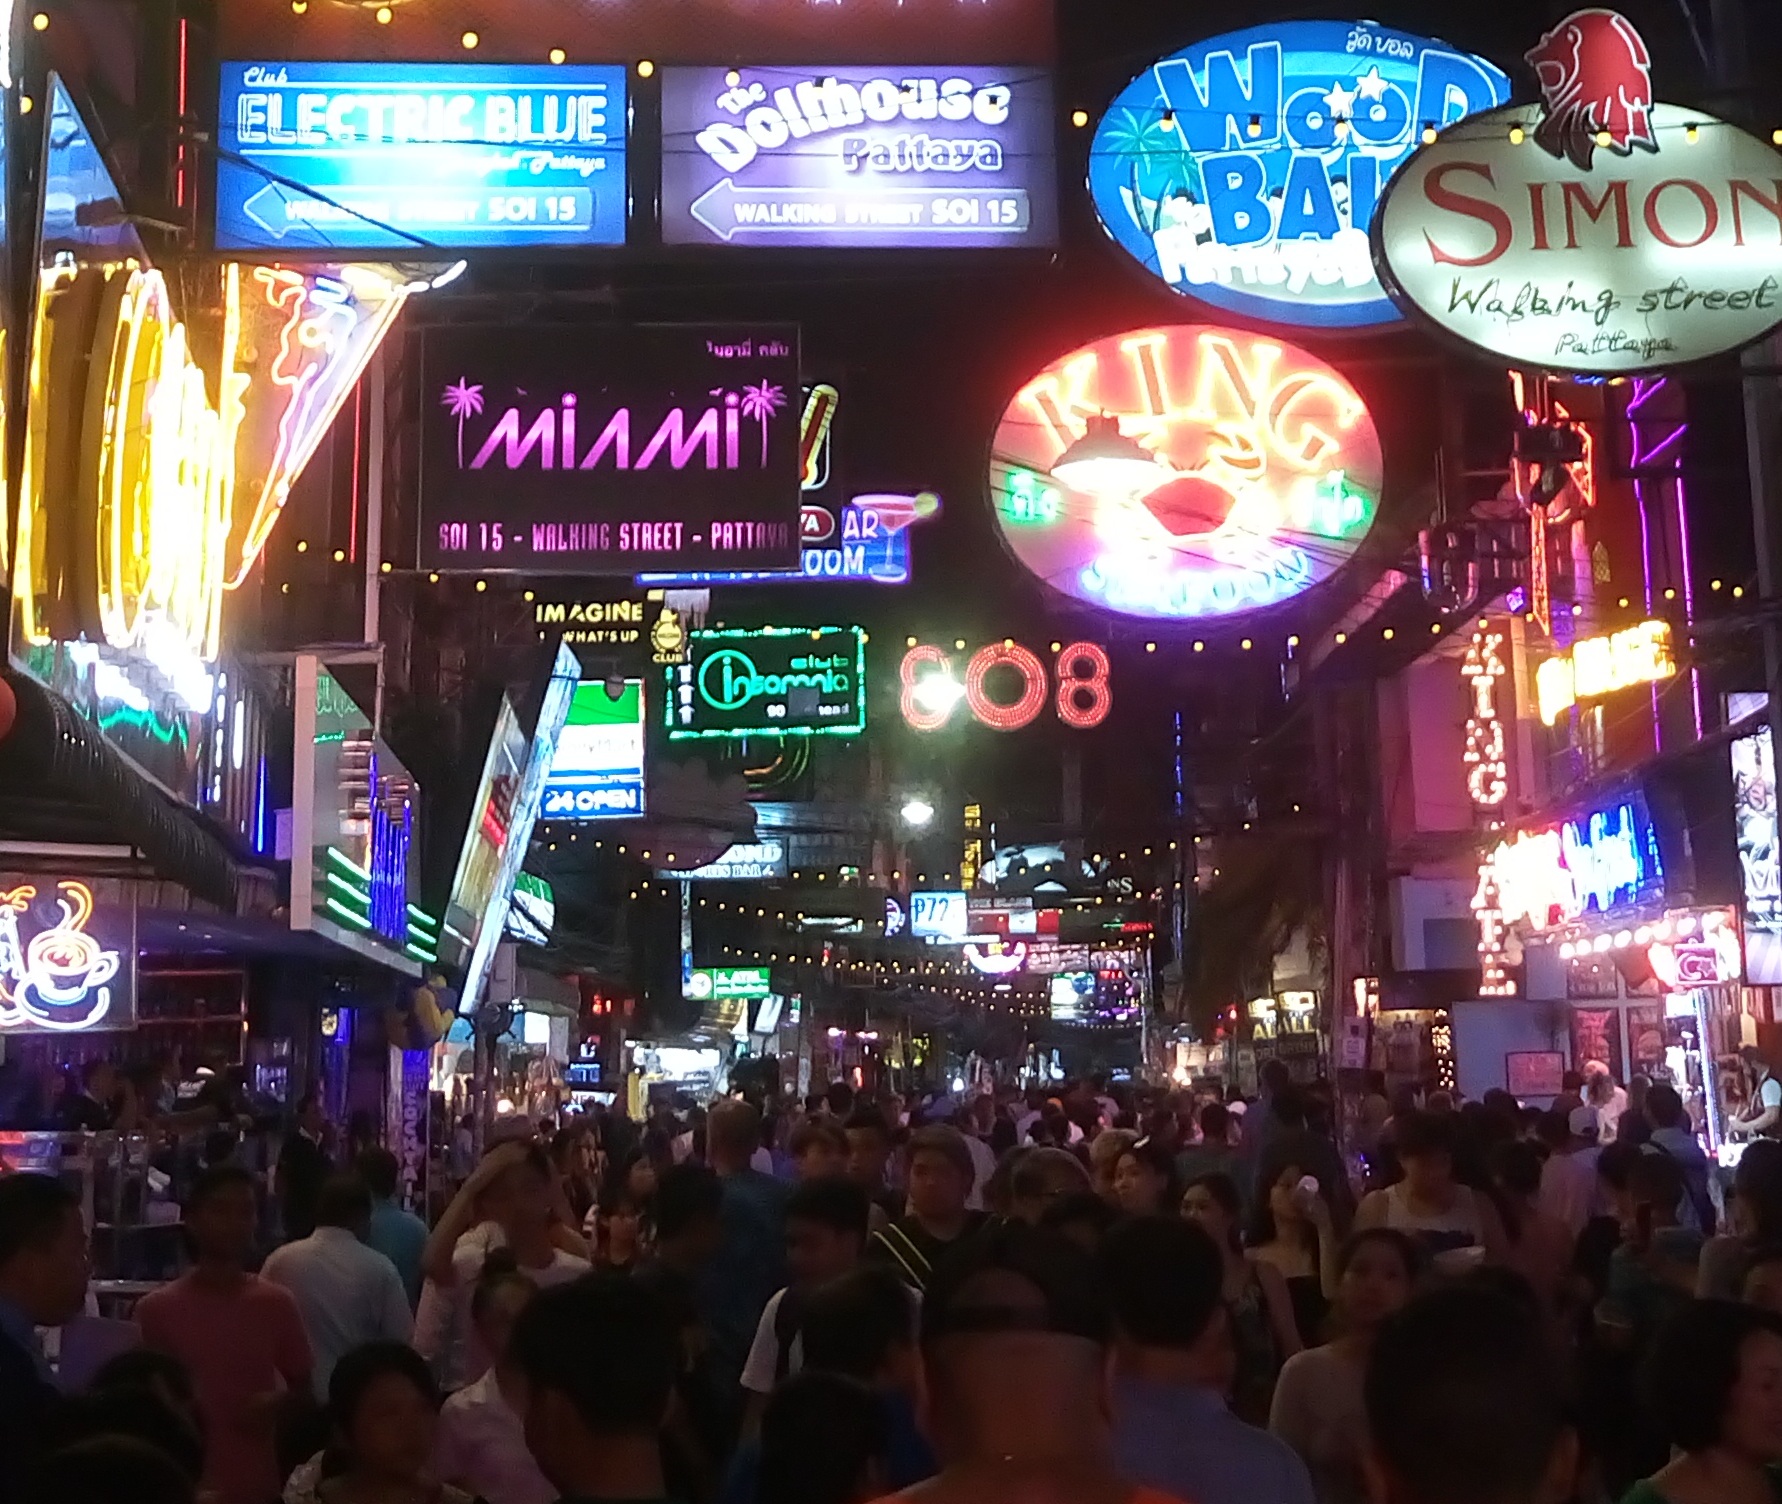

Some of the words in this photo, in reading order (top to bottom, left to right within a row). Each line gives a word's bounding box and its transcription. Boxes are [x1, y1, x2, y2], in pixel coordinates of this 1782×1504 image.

[244, 66, 289, 85] Club
[716, 82, 767, 115] The
[237, 92, 476, 145] ELECTRIC
[485, 94, 608, 145] BLUE
[695, 76, 1012, 173] Dollhouse
[842, 134, 1003, 172] Pattaya
[488, 196, 536, 222] SOI
[545, 196, 576, 222] 15
[734, 202, 837, 224] WALKING
[931, 199, 978, 224] SOI
[988, 199, 1018, 224] 15
[1019, 334, 1367, 470] KING
[439, 523, 469, 553] SOI
[479, 523, 504, 553] 15
[532, 523, 611, 553] WALKING
[619, 523, 685, 553] STREET
[711, 523, 789, 553] PATTAYA
[536, 601, 643, 623] IMAGINE
[620, 629, 639, 643] UP
[652, 653, 683, 663] CLUB
[1460, 633, 1507, 807] KING
[545, 789, 575, 812] 24
[576, 788, 638, 811] OPEN
